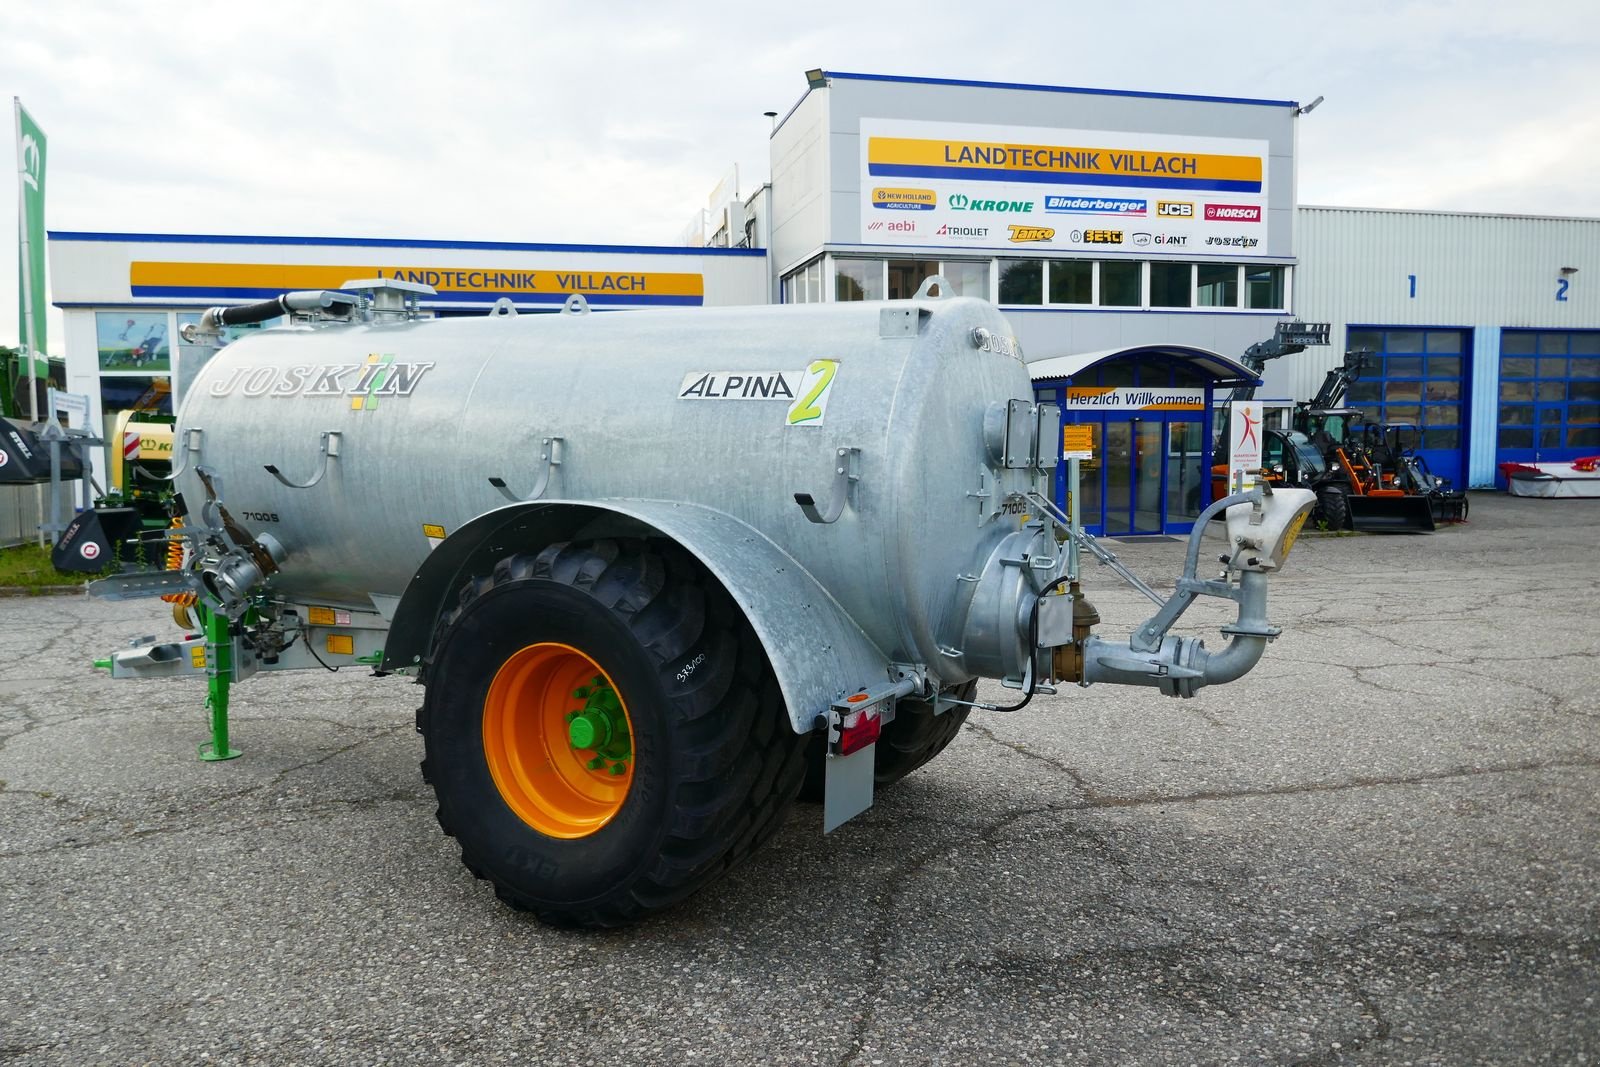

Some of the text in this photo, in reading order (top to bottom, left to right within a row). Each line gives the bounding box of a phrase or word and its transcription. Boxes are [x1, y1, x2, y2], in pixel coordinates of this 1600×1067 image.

[944, 144, 1197, 175] LANDTECHNIK VILLACH
[886, 192, 932, 202] NEW HOLLAND
[1048, 196, 1146, 213] Binderberger
[969, 199, 1034, 213] KRONE
[1158, 203, 1193, 216] JCB
[1216, 207, 1258, 219] HORSCH
[887, 219, 915, 232] aebi
[947, 226, 989, 236] TRIOLIET
[1009, 225, 1055, 242] Tanco
[1205, 235, 1259, 248] JOSKIN
[556, 273, 647, 292] VILLACH
[1408, 274, 1416, 298] 1
[1556, 278, 1569, 302] 2
[211, 360, 436, 397] JOSKIN
[679, 360, 837, 425] ALPINA 2
[1070, 391, 1203, 406] Herzlich Willkommen
[1001, 501, 1027, 516] 7100S
[242, 511, 280, 523] 7100S
